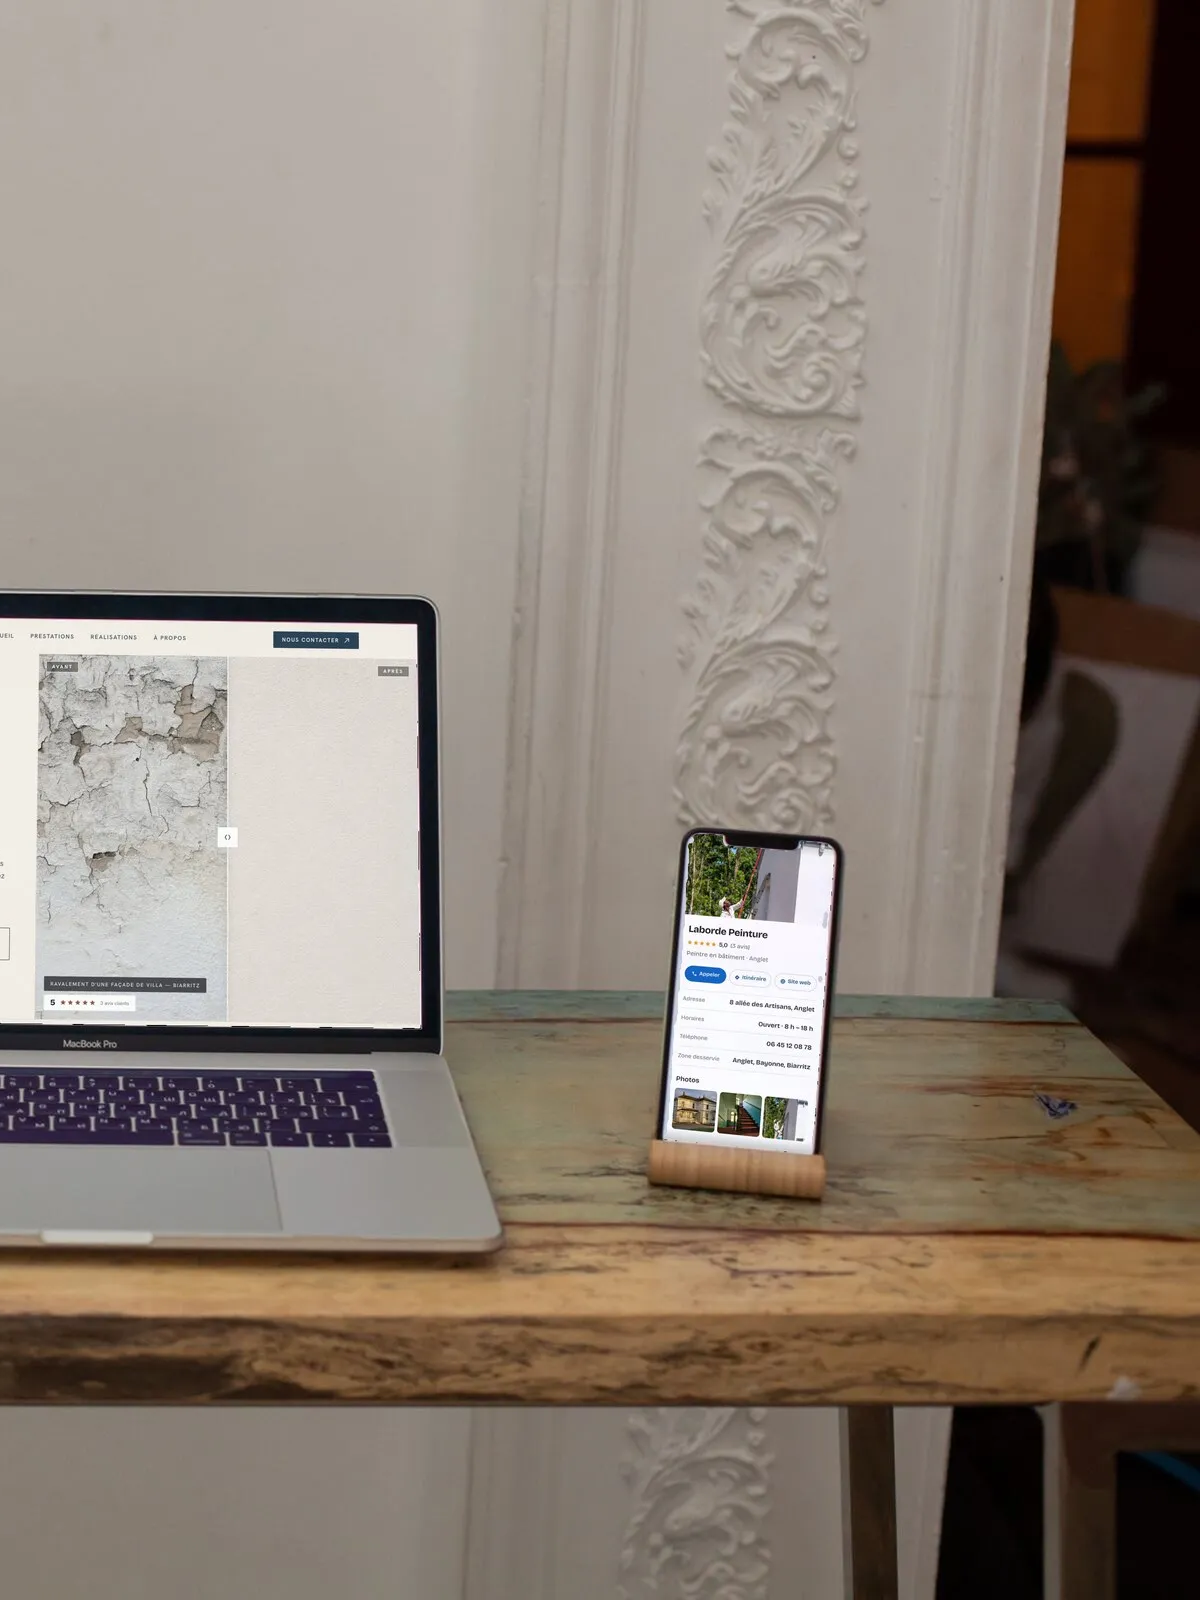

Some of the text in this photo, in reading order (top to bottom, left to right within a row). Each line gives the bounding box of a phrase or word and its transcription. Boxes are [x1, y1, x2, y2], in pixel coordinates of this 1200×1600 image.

[688, 925, 768, 939] Laborde Peinture
[686, 950, 708, 958] Peintre
[718, 952, 745, 961] bâtiment
[764, 1002, 793, 1011] Artisans,
[793, 1005, 815, 1013] Anglet
[758, 1021, 780, 1029] Ouvert
[63, 1039, 118, 1049] MacBook Pro
[732, 1057, 811, 1070] Anglet, Bayonne, Biarritz
[676, 1075, 700, 1084] Photos
